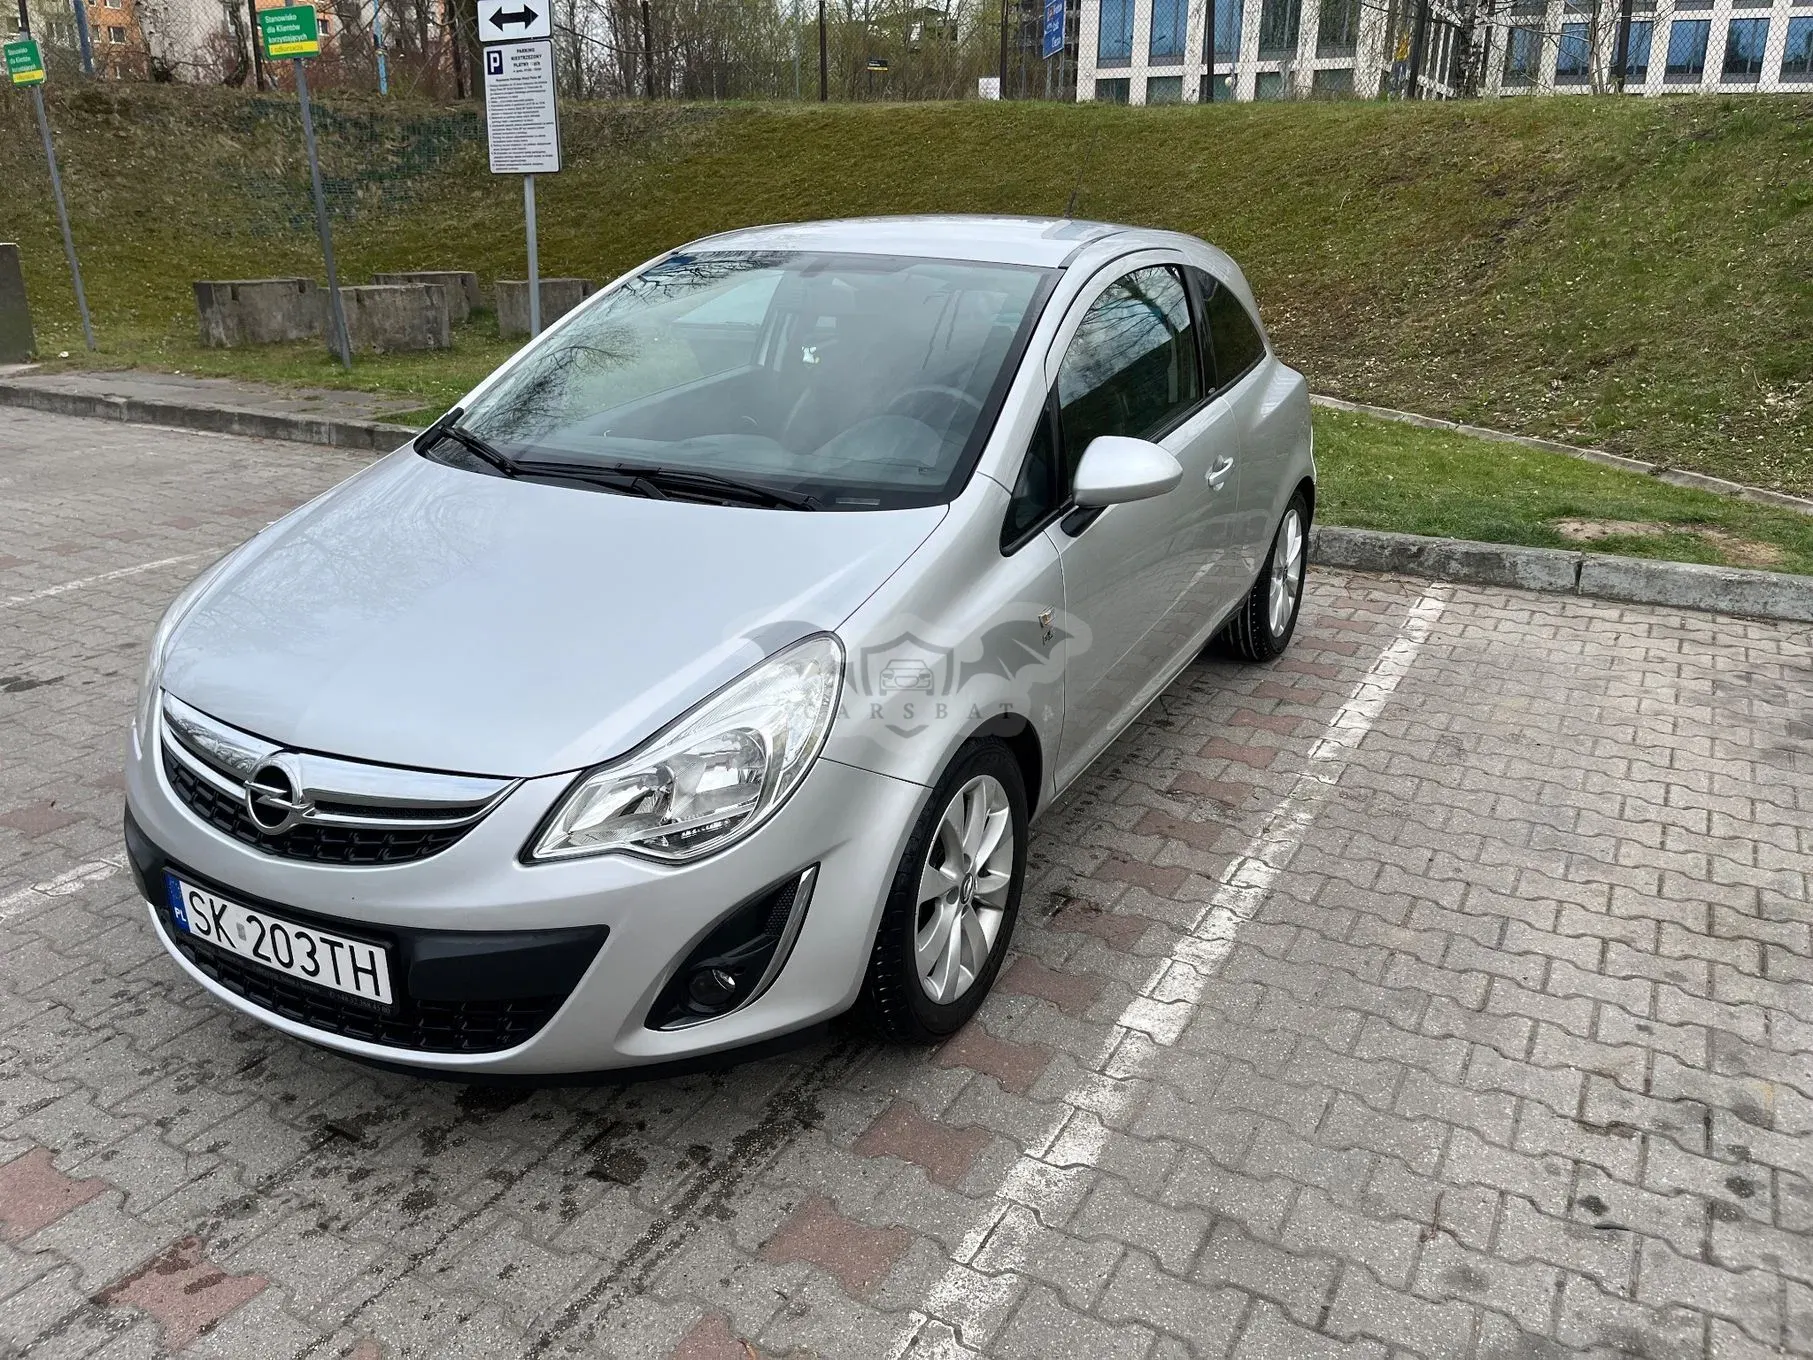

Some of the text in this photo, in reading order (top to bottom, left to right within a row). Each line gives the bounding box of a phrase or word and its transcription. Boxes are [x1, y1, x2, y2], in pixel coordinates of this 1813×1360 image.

[265, 13, 297, 23] Stanowisko
[174, 906, 187, 922] PL
[189, 891, 236, 949] SK
[246, 915, 381, 997] 203TH
